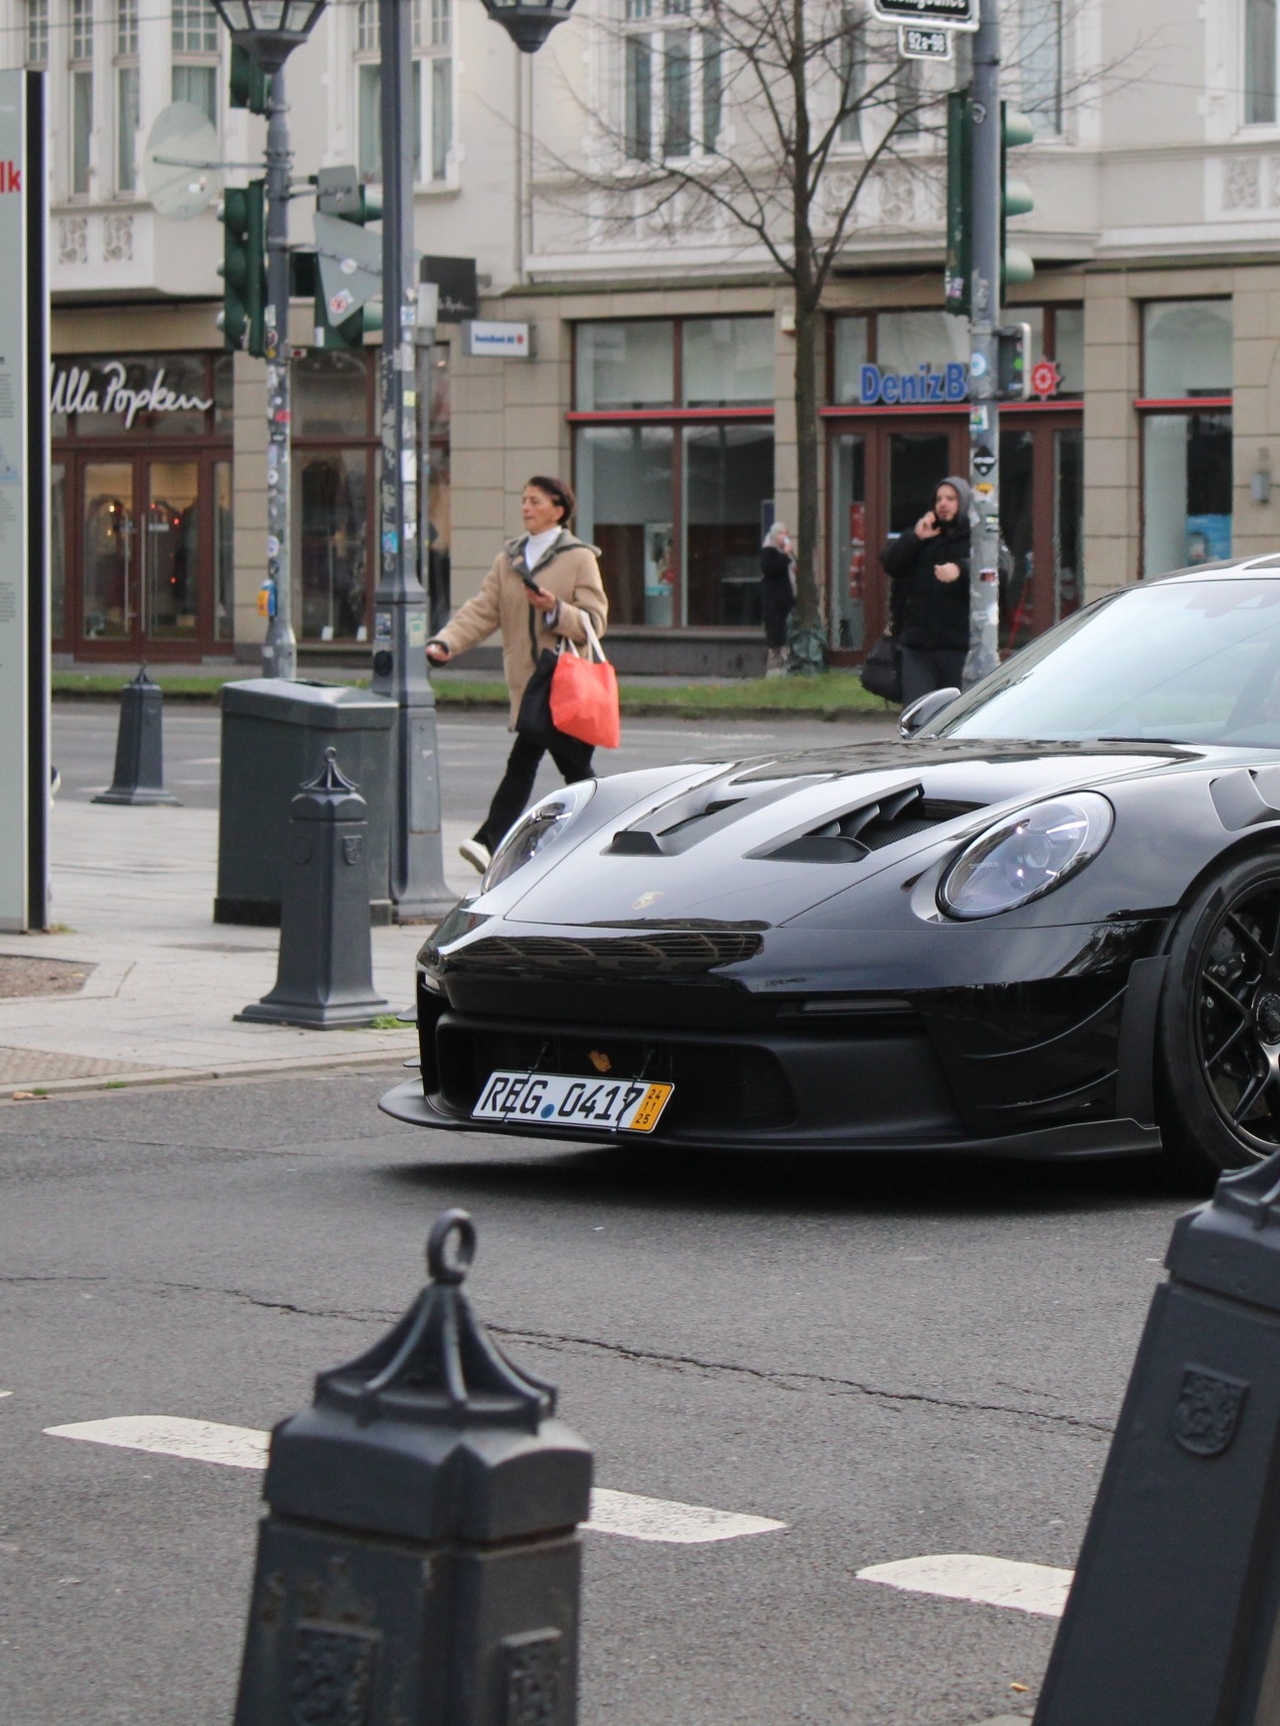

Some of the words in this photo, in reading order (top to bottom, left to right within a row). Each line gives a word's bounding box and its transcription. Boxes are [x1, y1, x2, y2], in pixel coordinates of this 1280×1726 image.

[102, 361, 213, 430] Popken
[860, 363, 970, 404] DenizB
[480, 1076, 549, 1115] REG
[557, 1083, 644, 1121] 0417
[643, 1098, 657, 1112] 11
[648, 1088, 662, 1100] 24
[635, 1113, 651, 1125] 25
